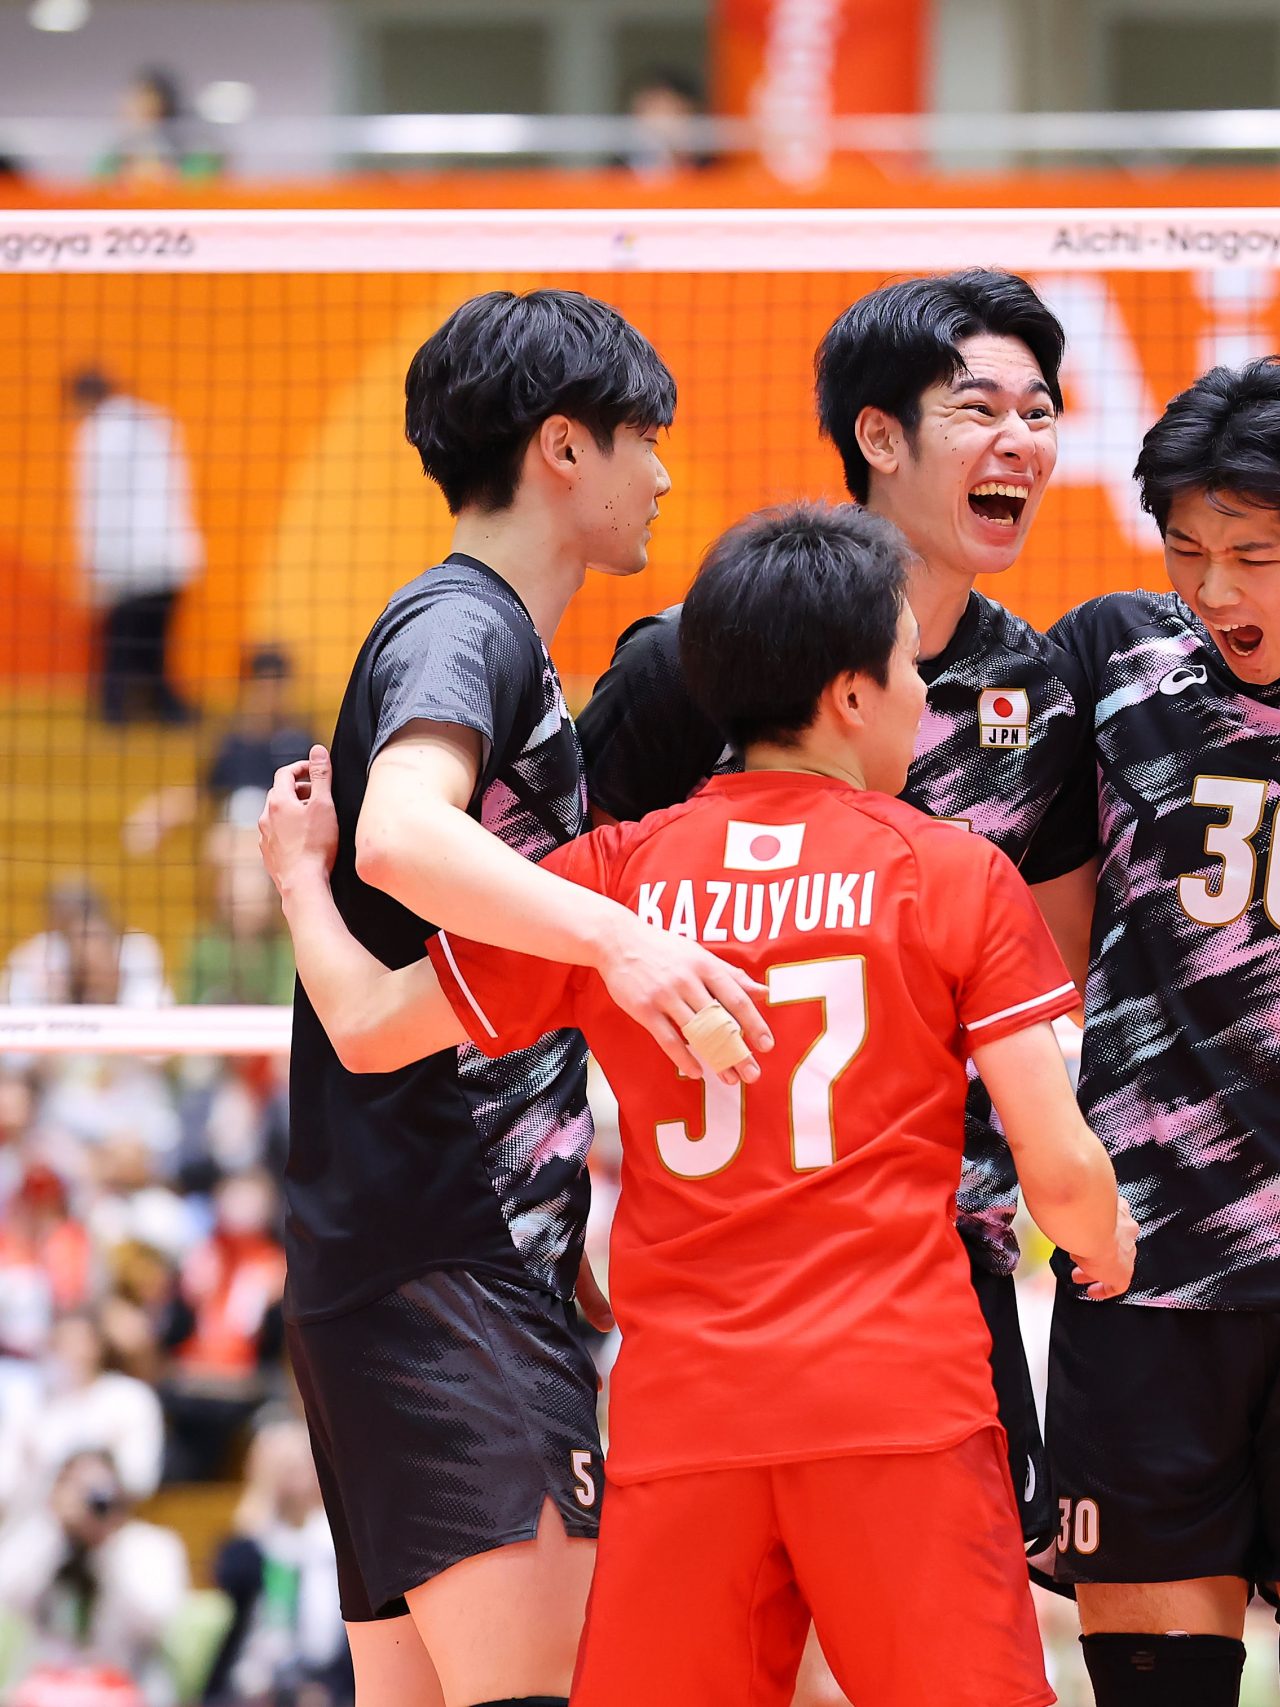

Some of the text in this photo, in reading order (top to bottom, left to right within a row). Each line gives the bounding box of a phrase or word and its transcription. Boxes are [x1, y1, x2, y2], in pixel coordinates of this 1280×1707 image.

[0, 226, 194, 267] goya 2026
[988, 729, 1019, 744] JPN
[637, 870, 876, 943] KAZUYUKI
[570, 1449, 596, 1508] 5
[1056, 1497, 1100, 1555] 30
